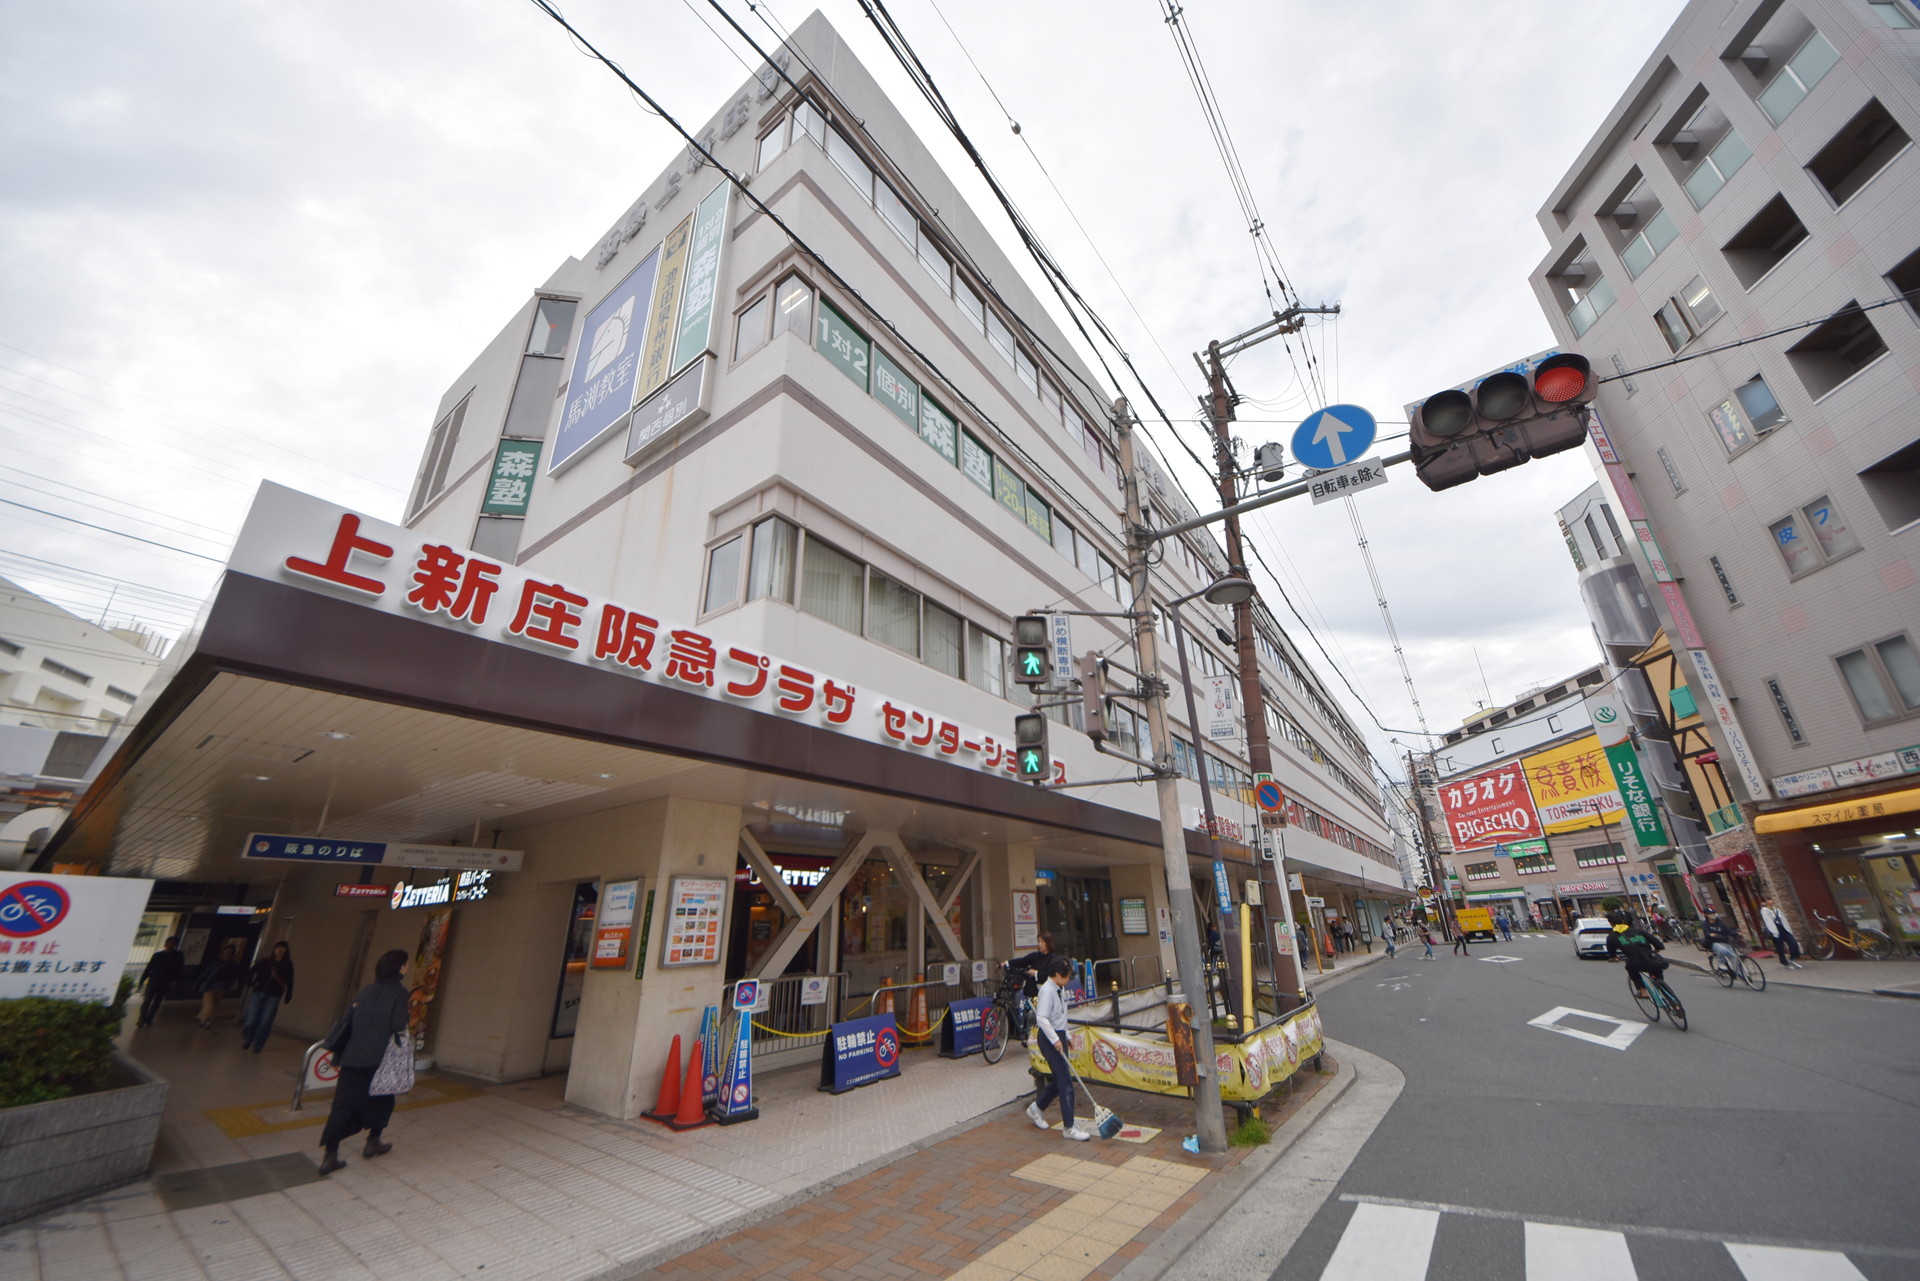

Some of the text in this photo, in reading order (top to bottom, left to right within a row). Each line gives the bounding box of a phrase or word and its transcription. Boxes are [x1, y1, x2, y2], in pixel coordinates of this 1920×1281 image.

[685, 245, 717, 321] 森塾
[646, 267, 678, 390] 池田泉州銀行
[818, 317, 868, 377] 1対2
[876, 363, 916, 416] 個別
[564, 352, 634, 432] 馬渕教室
[488, 449, 534, 507] 森塾
[1312, 467, 1382, 498] 自転車を除く
[285, 512, 1068, 785] 上新庄阪急プラザ センターショス
[1055, 617, 1070, 676] 斜め横断専用
[1447, 772, 1515, 810] カラオケ
[1617, 761, 1657, 833] りそな銀行
[1813, 803, 1884, 825] スマイル薬局
[284, 842, 364, 858] 阪急のりば
[349, 886, 387, 897] ZETTERIA
[400, 884, 450, 908] ZETTERIA
[953, 1008, 982, 1024] 駐輪禁止
[737, 1039, 749, 1080] 駐輪禁止
[836, 1029, 876, 1052] 駐輪禁止
[838, 1046, 874, 1061] NO PARKING
